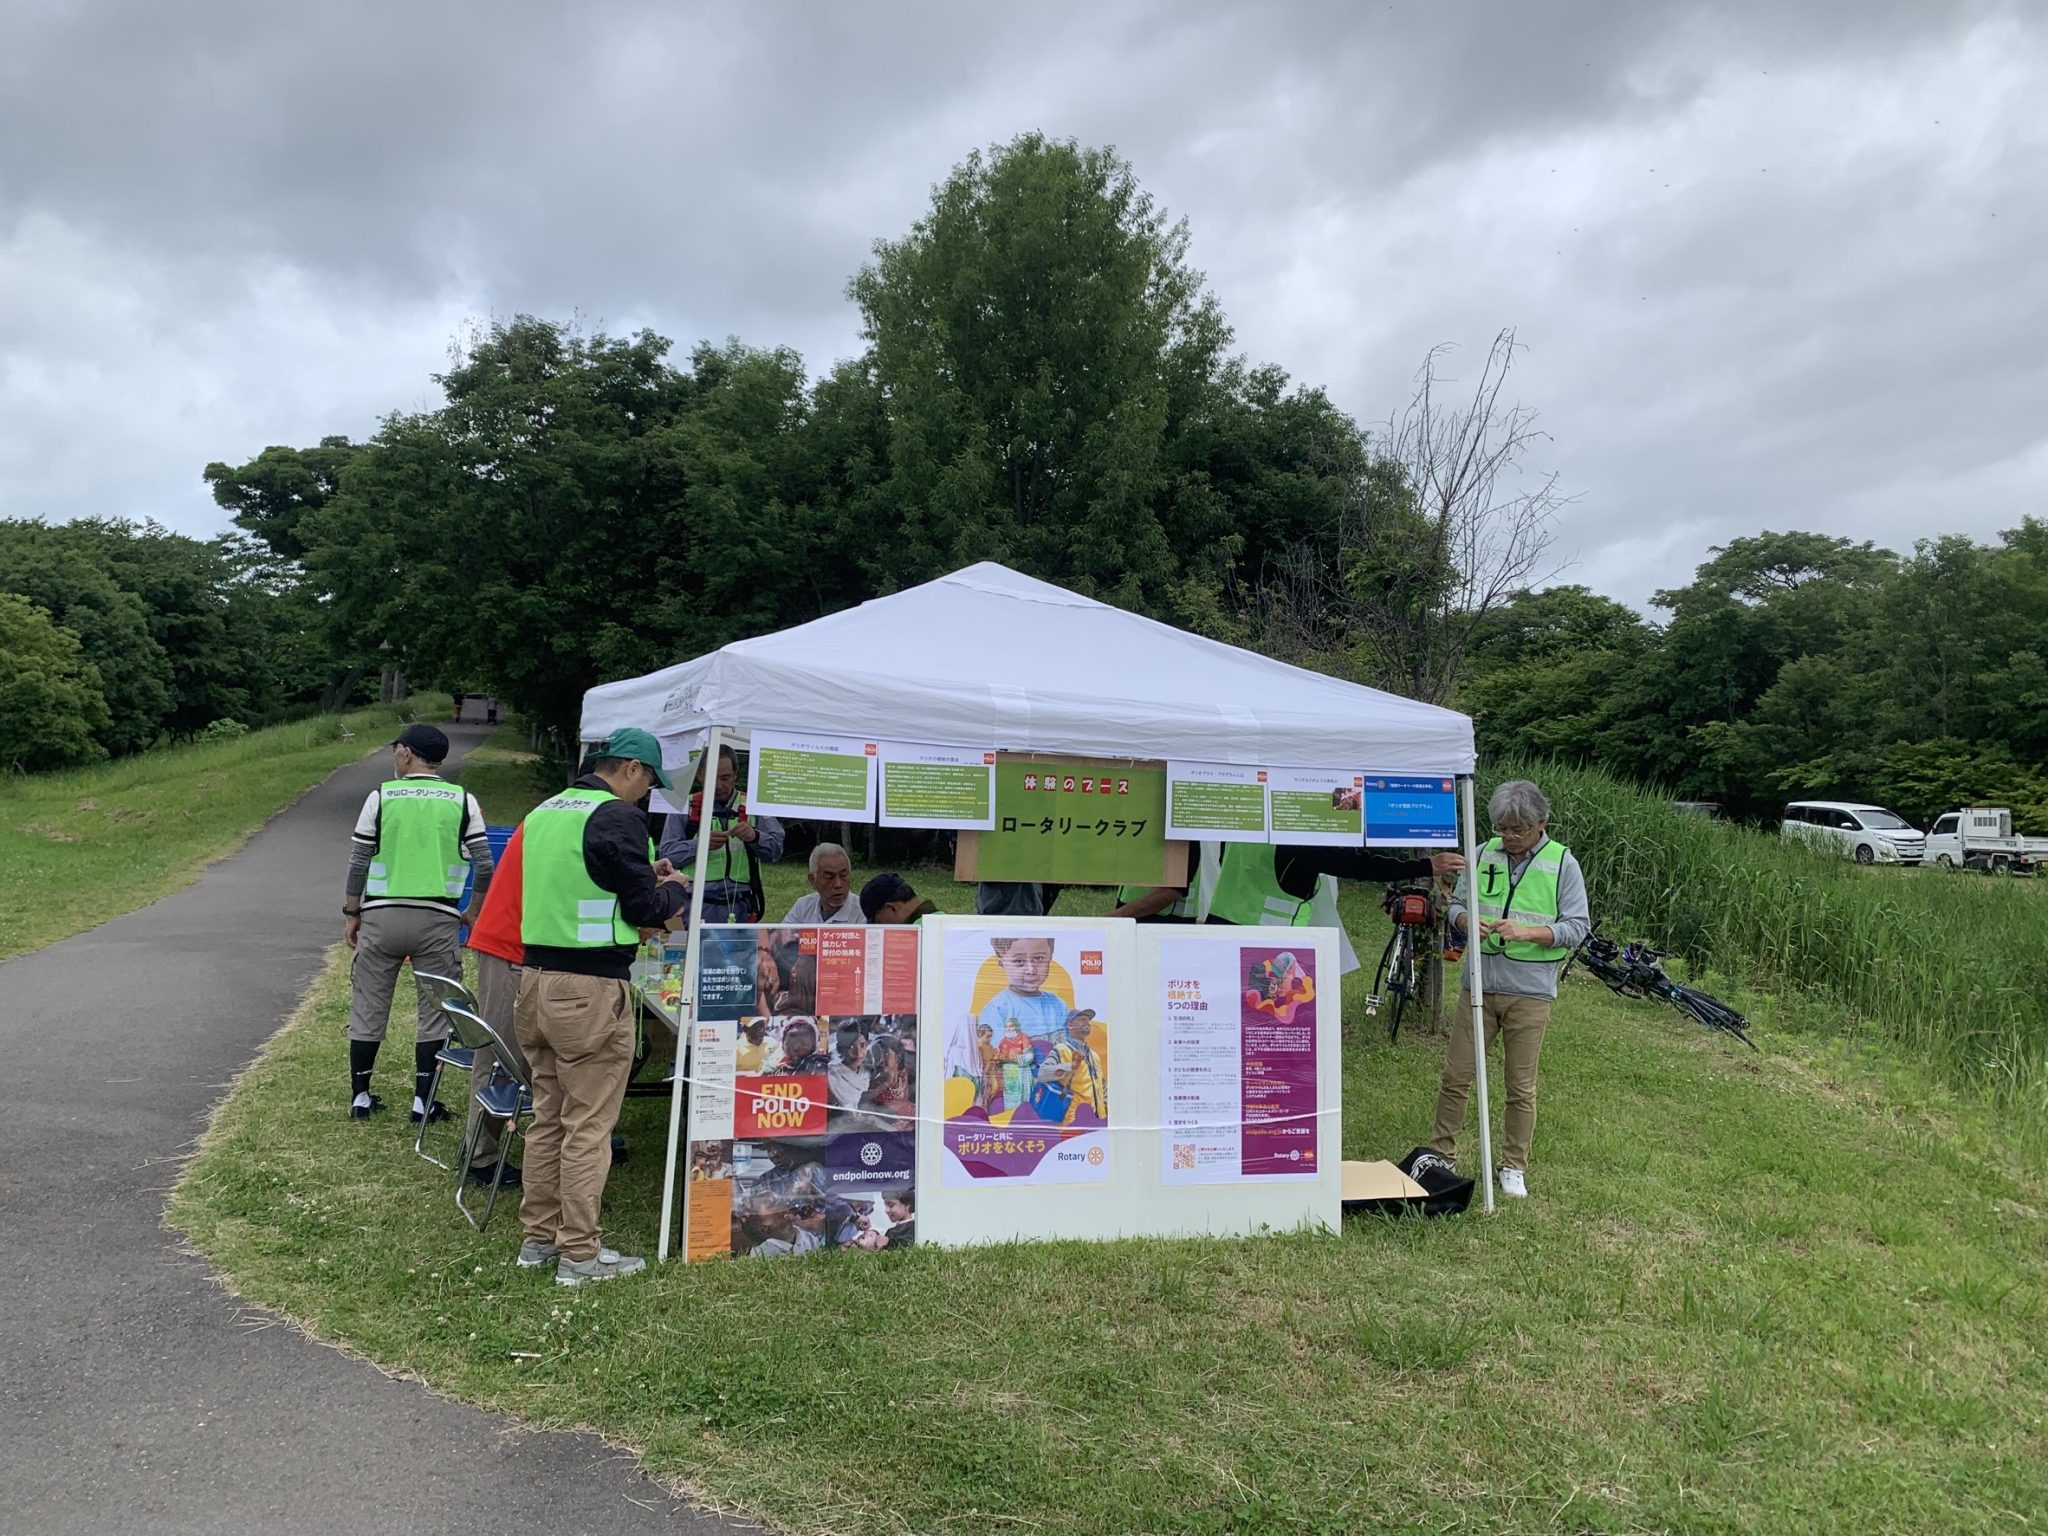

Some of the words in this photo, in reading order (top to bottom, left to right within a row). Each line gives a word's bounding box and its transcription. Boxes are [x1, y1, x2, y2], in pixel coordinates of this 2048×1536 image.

[1025, 775, 1128, 793] 体験のブース
[1002, 817, 1147, 837] ロータリークラブ
[822, 949, 861, 957] 寄付の効果を
[1168, 980, 1200, 989] ポリオを
[1168, 1001, 1208, 1011] 5つの理由
[761, 1083, 802, 1099] END
[752, 1098, 810, 1114] POLIO
[757, 1112, 805, 1128] NOW
[958, 1132, 1013, 1141] ロータリーと共に
[958, 1140, 1046, 1155] ポリオをなくそう
[1058, 1152, 1085, 1163] Rotary
[833, 1170, 910, 1182] endpolionow.org
